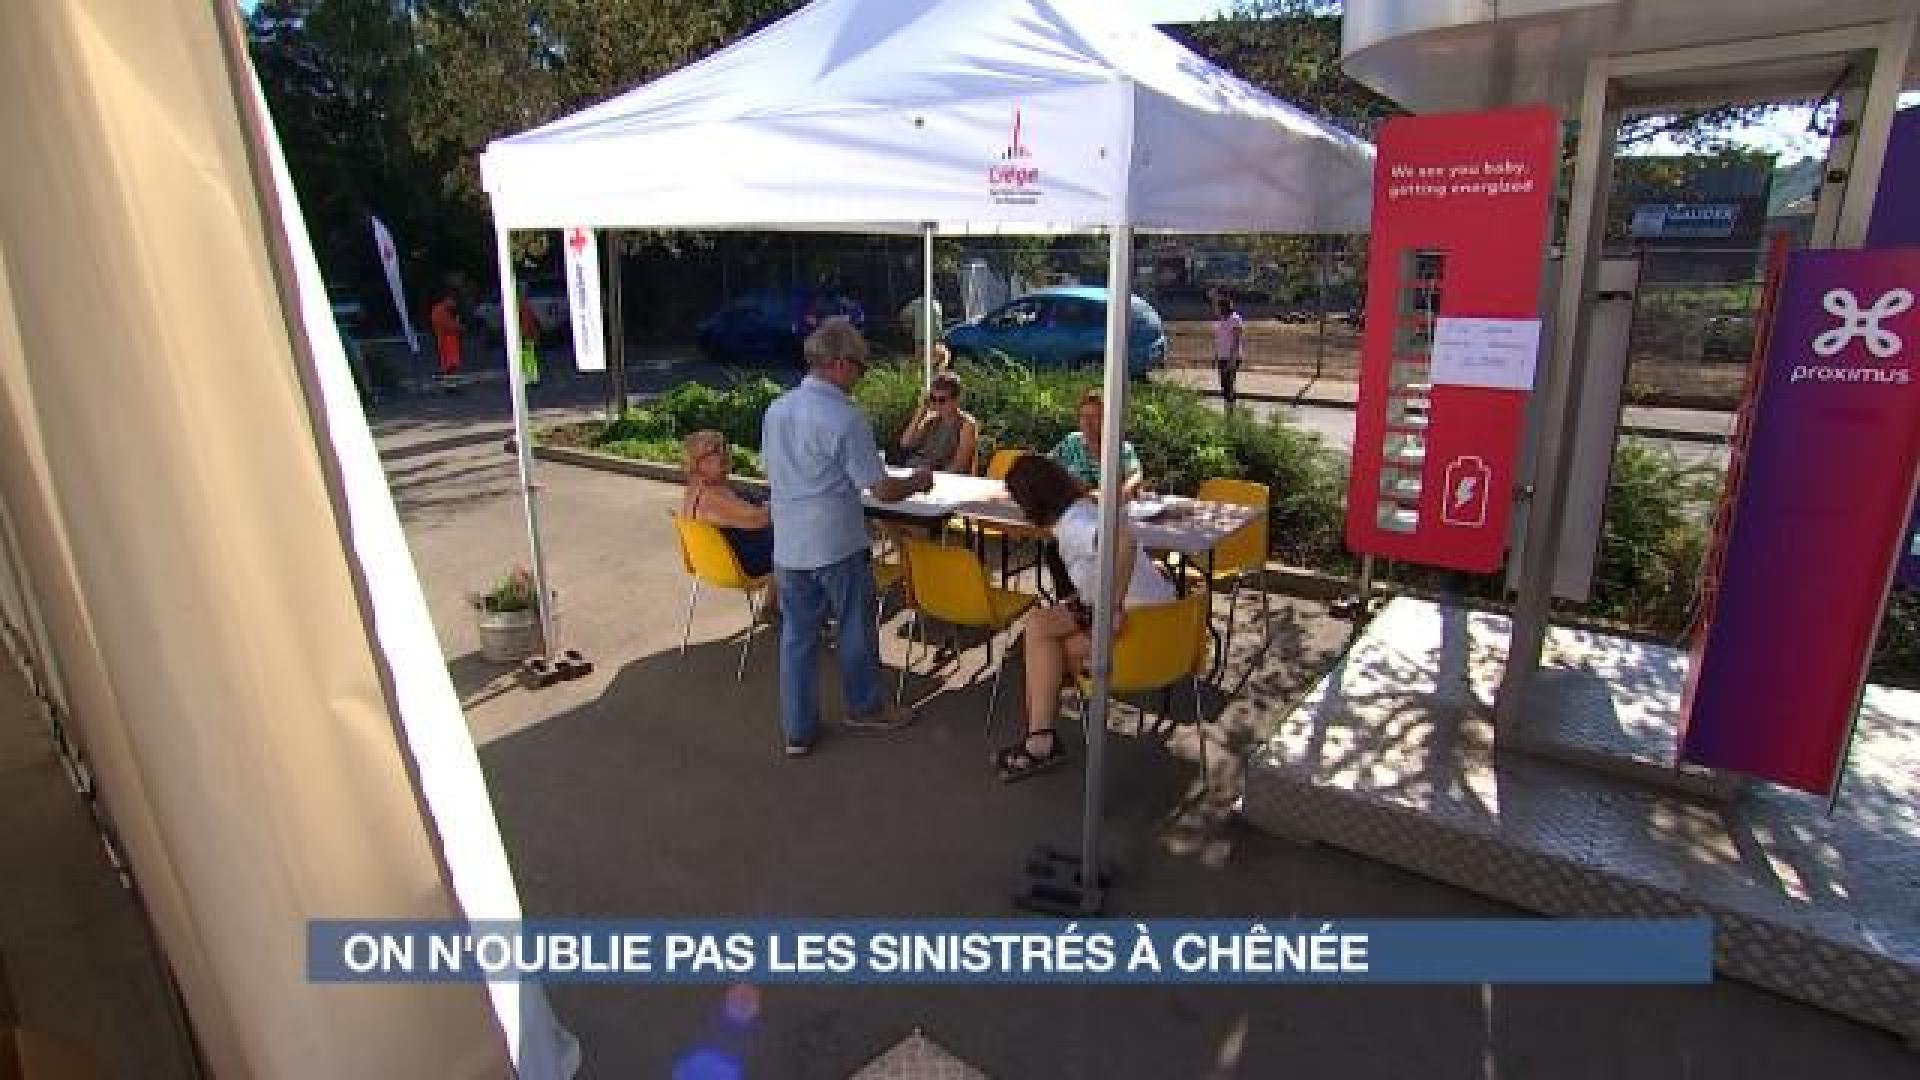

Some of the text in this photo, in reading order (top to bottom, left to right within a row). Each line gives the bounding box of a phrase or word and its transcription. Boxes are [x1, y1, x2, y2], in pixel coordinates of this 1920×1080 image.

[1418, 167, 1444, 178] see
[1449, 165, 1480, 180] you
[1388, 178, 1534, 200] getting energized
[1790, 365, 1910, 385] proximus
